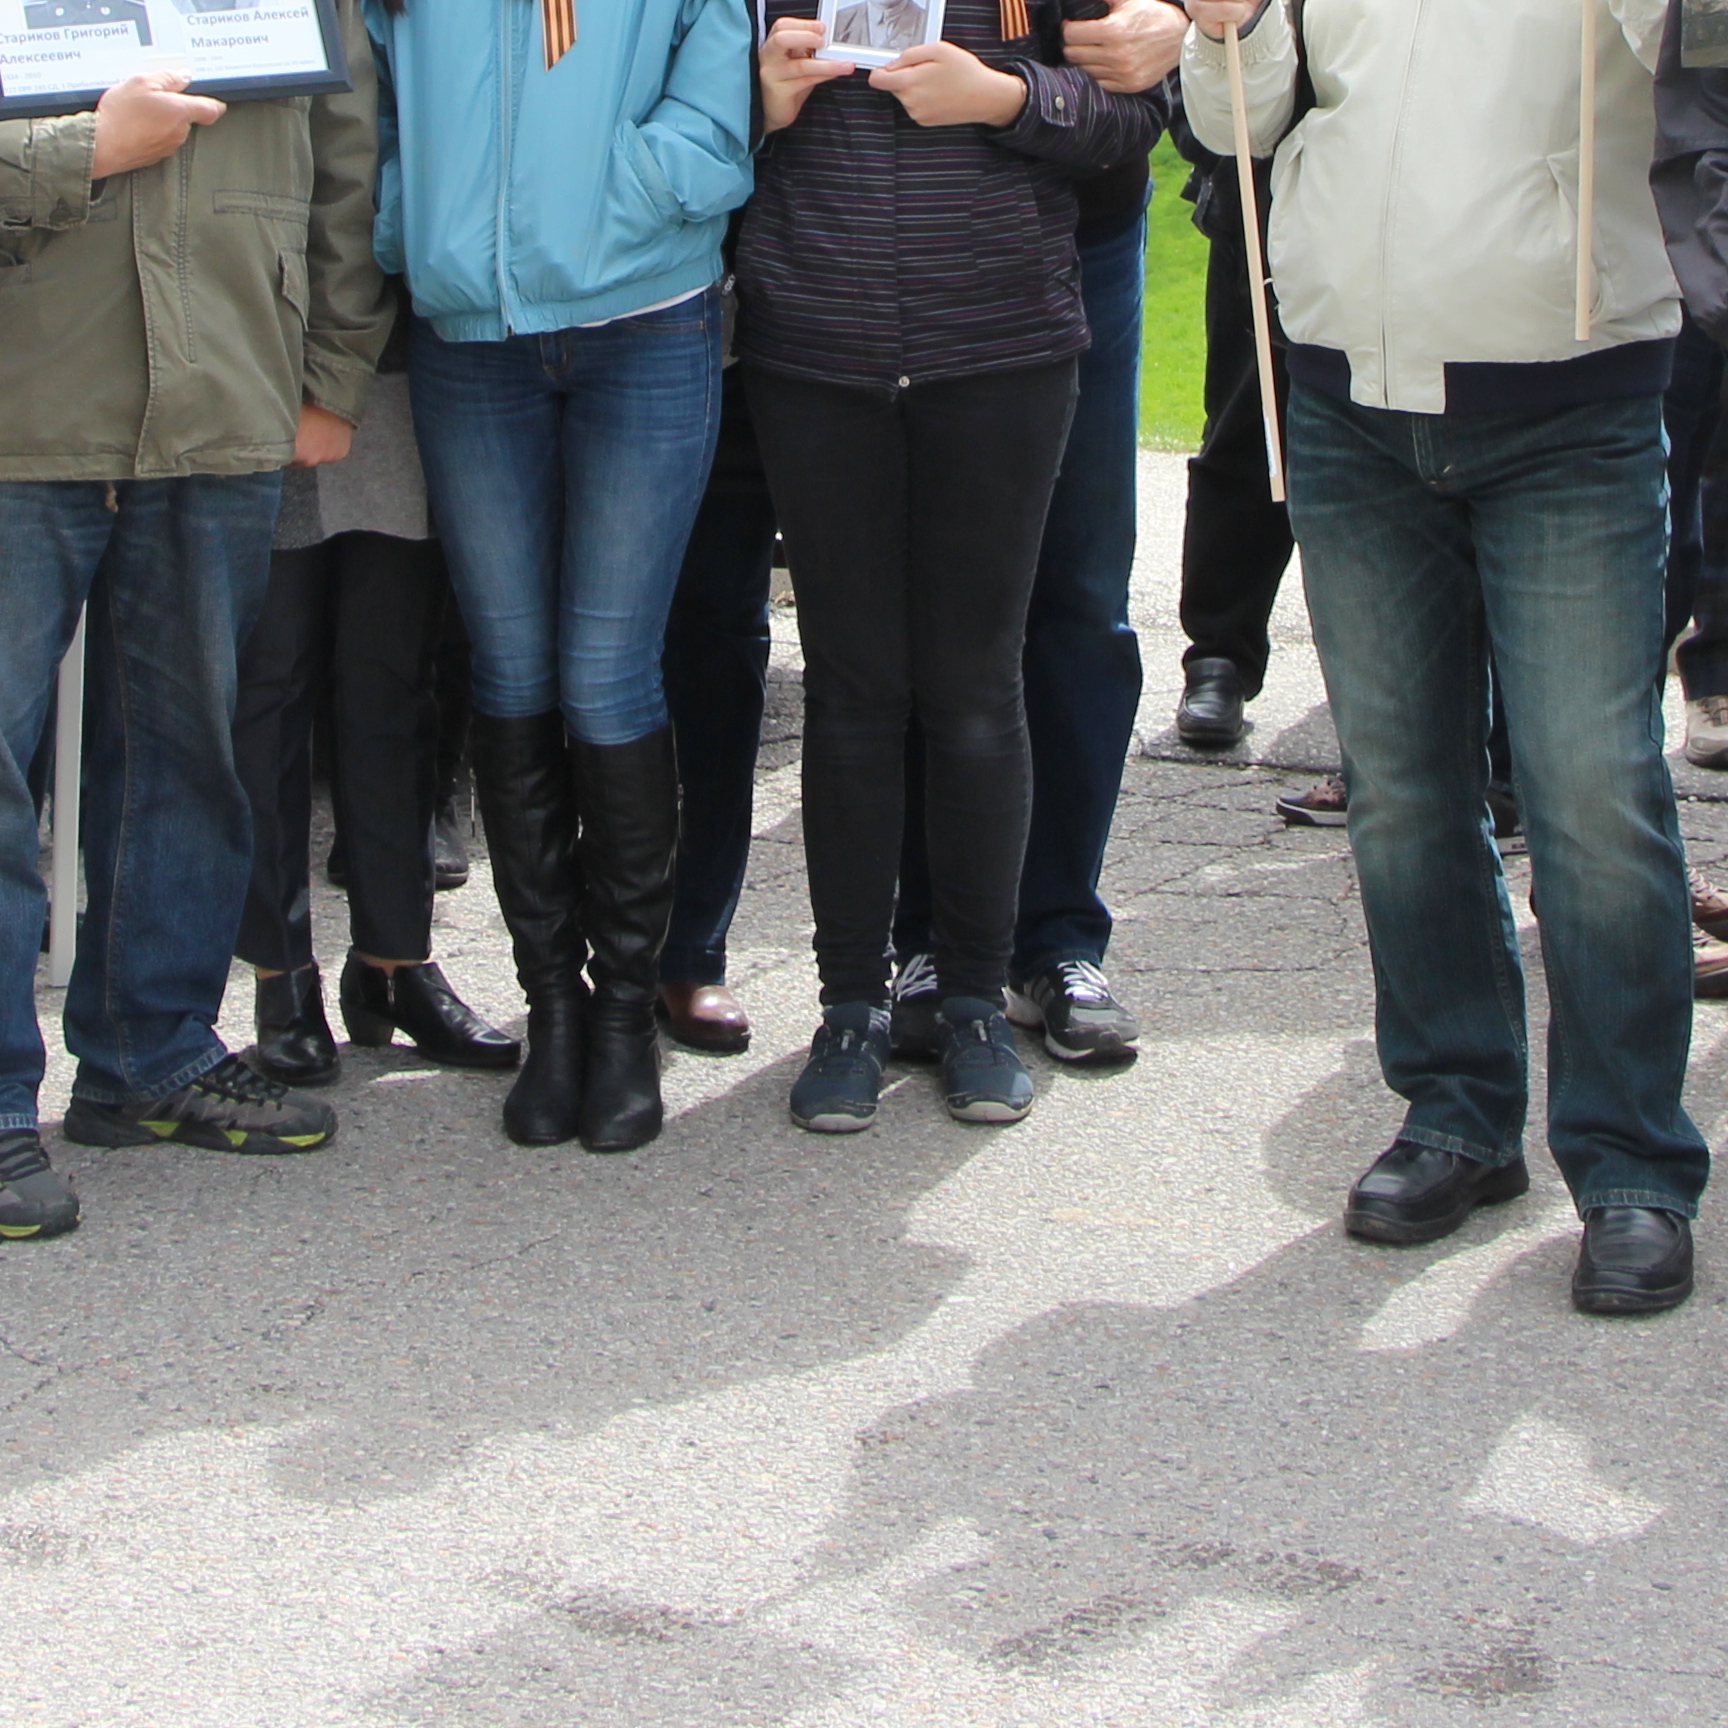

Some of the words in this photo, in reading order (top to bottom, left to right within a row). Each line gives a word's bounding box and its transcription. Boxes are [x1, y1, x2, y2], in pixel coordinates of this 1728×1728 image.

[187, 12, 250, 27] Стариков
[254, 6, 309, 22] Алексей
[64, 24, 129, 41] Григорий
[191, 34, 269, 49] Макарович
[0, 49, 82, 65] Алексеевич
